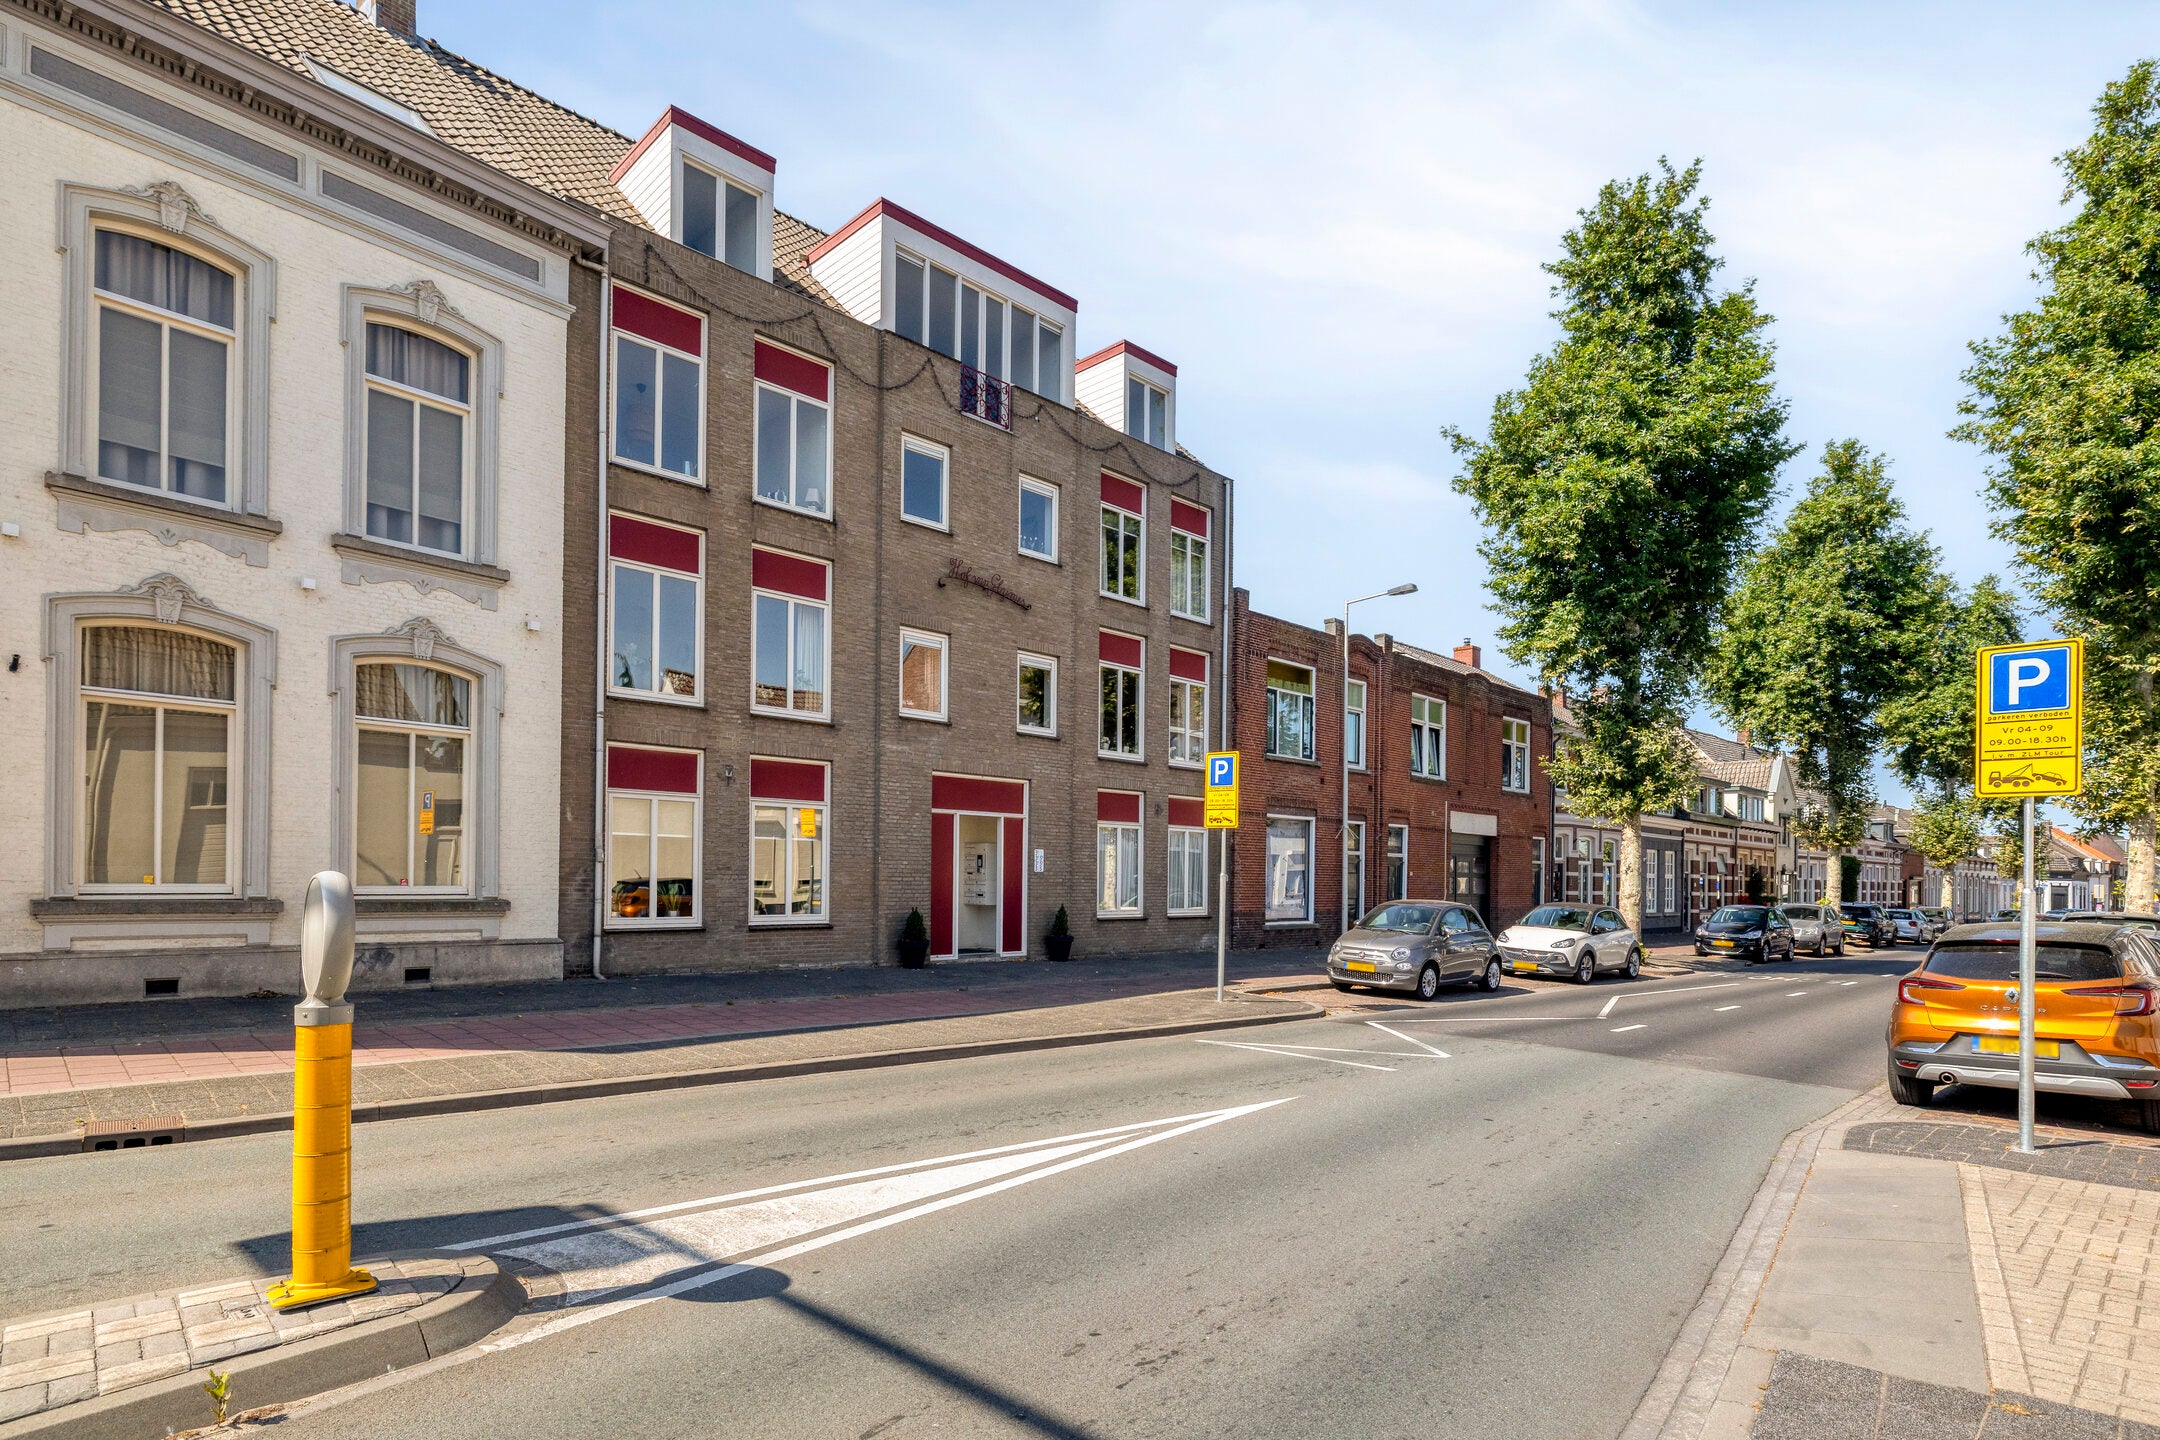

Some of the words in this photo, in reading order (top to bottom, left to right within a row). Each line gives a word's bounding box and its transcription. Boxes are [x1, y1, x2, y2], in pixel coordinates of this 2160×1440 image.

[2008, 657, 2051, 706] P
[1987, 713, 2026, 721] parkeren
[2017, 724, 2053, 733] 04-09
[2021, 750, 2041, 758] ZLM
[1214, 760, 1229, 784] P
[1980, 1004, 2048, 1014] CAPTR
